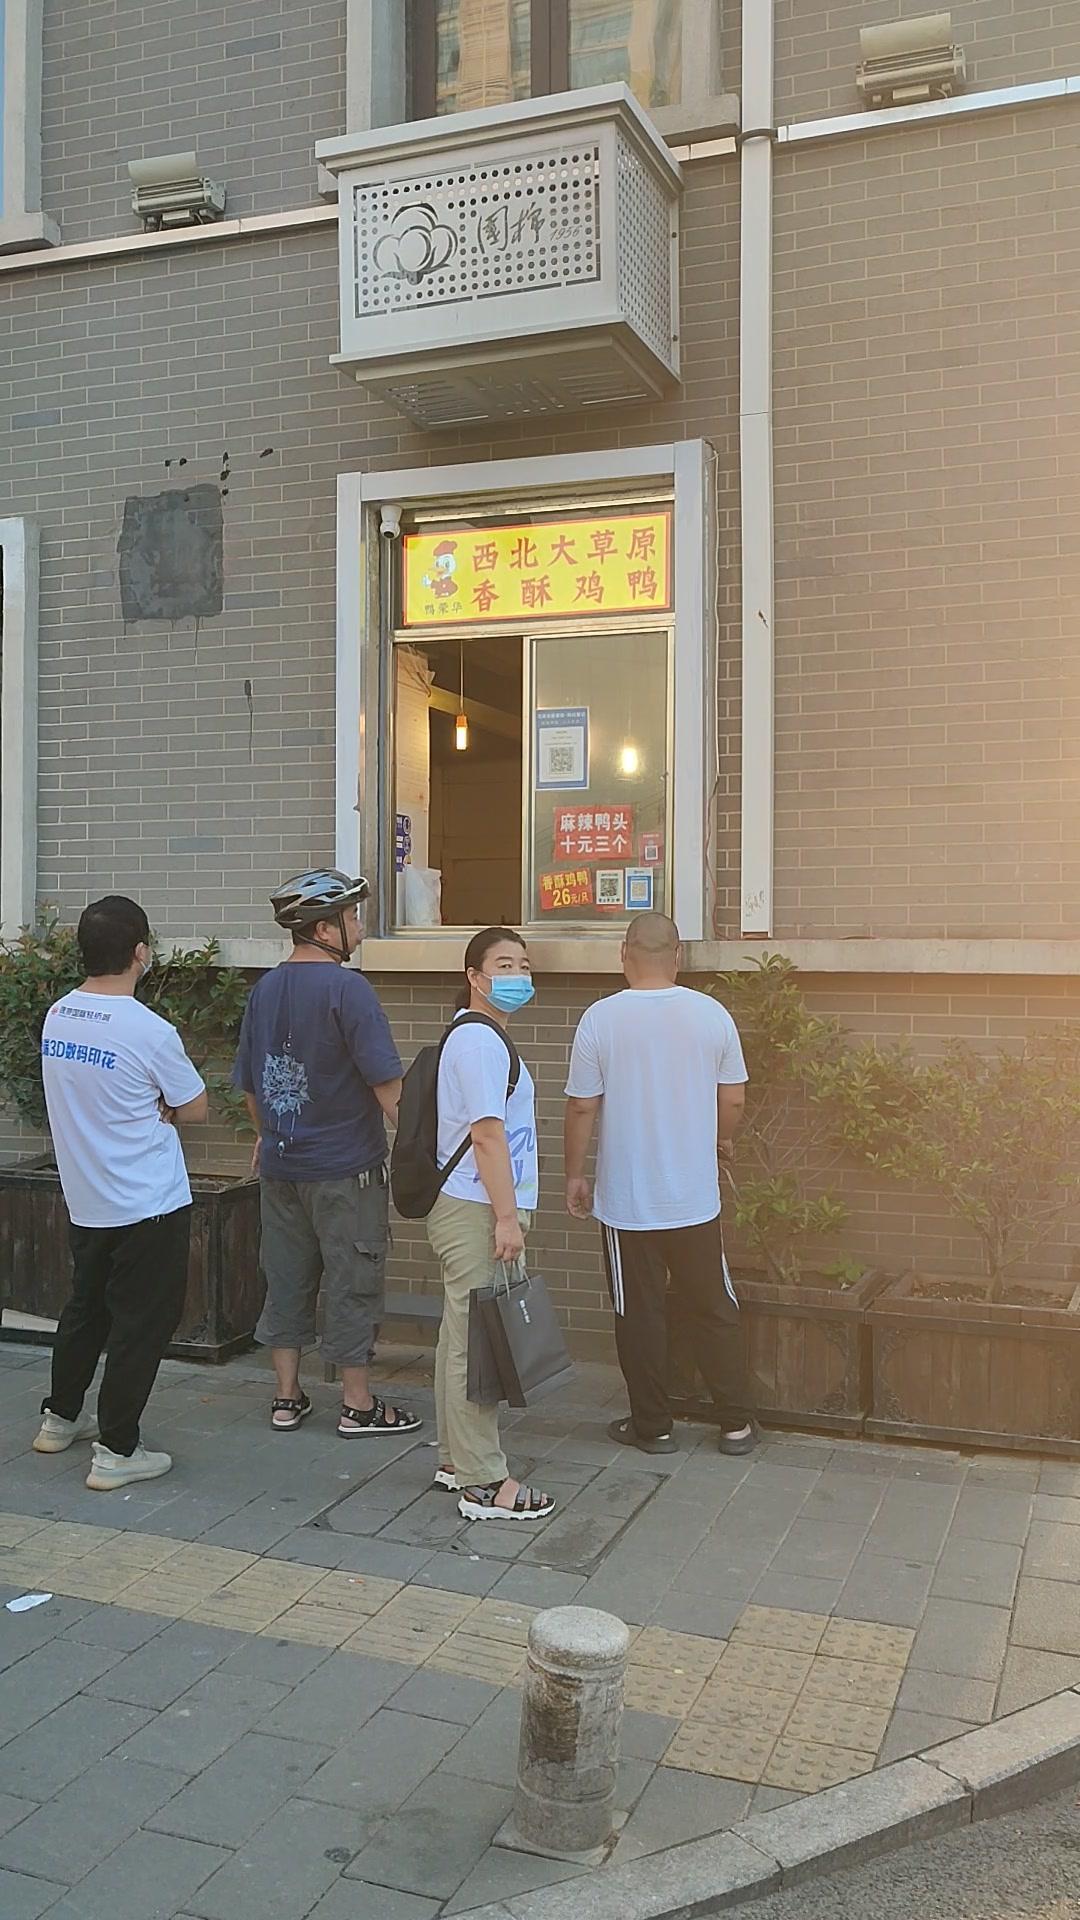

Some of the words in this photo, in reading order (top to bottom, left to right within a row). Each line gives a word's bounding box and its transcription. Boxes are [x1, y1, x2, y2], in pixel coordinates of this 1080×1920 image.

[472, 526, 658, 572] 西北大草原
[472, 566, 659, 612] 香酥鸡鸭
[560, 812, 628, 832] 麻辣鸭头
[560, 835, 628, 854] 十元三个
[543, 870, 589, 892] 香酥鸡鸭
